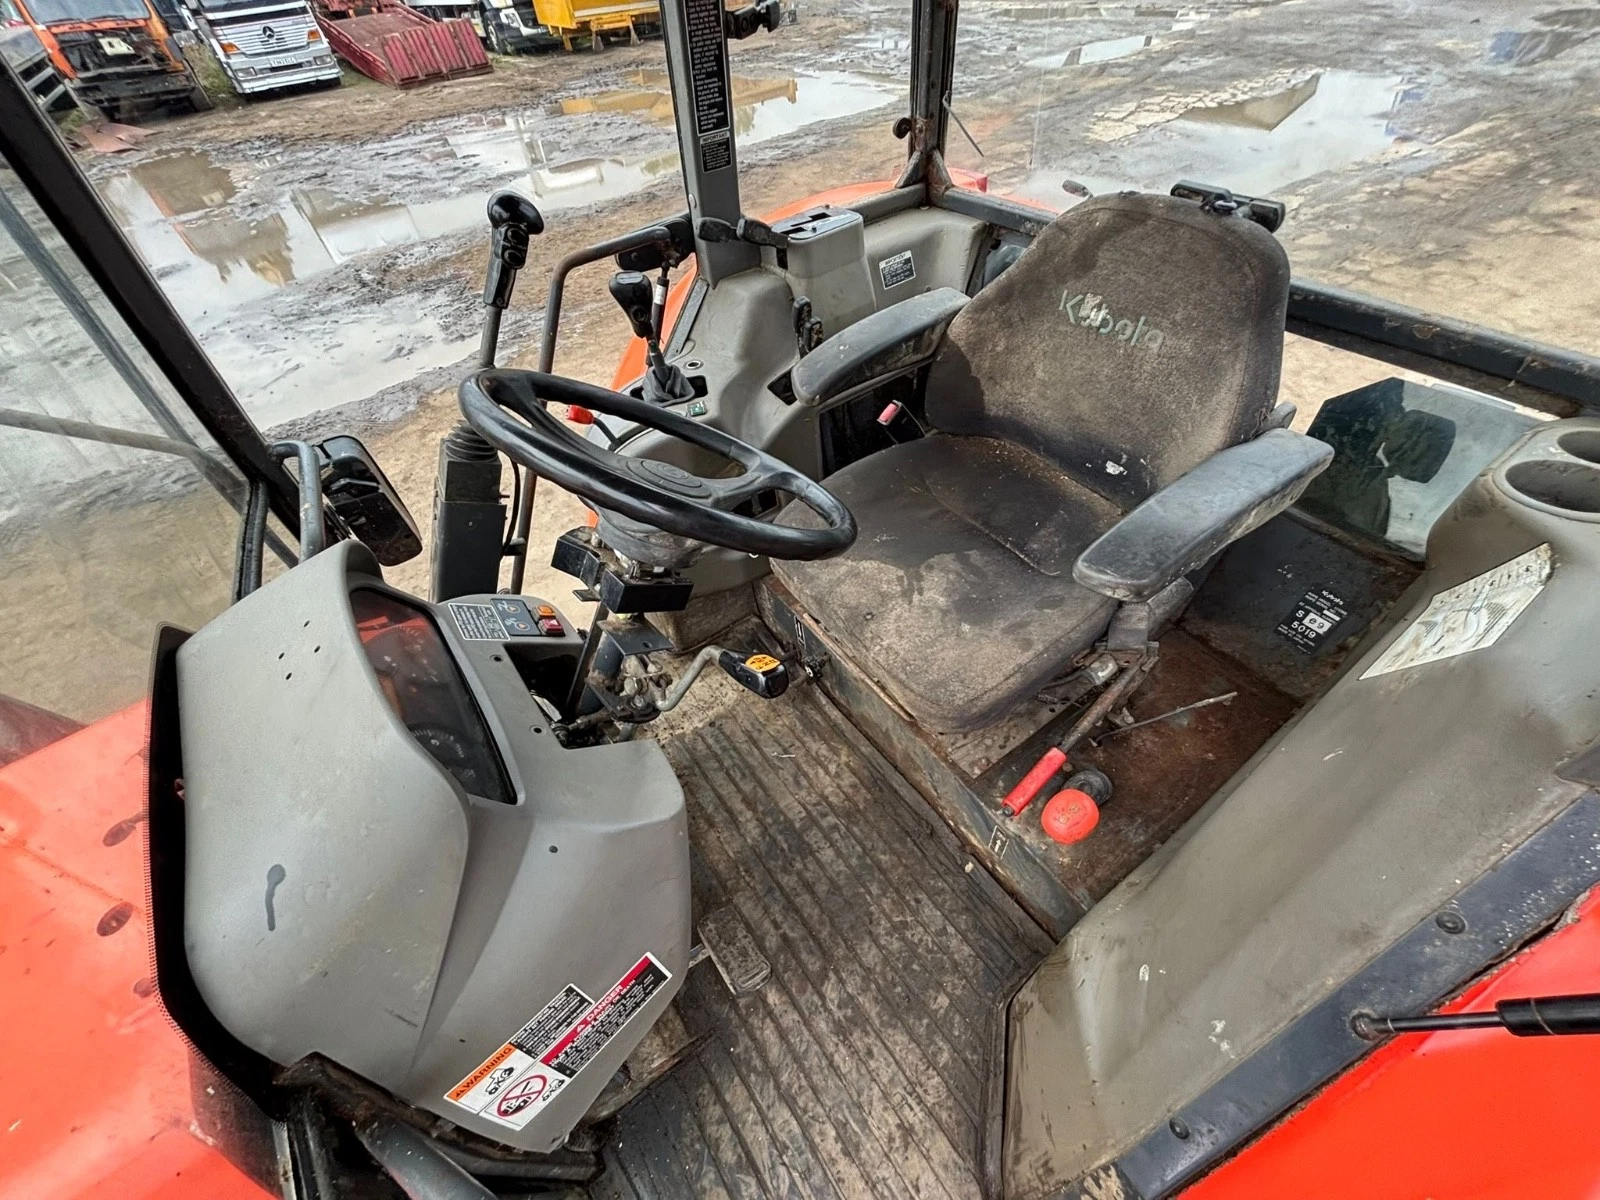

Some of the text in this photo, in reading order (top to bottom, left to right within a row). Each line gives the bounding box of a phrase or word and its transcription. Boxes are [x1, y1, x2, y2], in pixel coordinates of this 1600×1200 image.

[1296, 610, 1305, 618] S
[1291, 621, 1315, 638] 5019
[585, 985, 623, 1021] DANGER
[463, 1045, 513, 1089] WARNING
